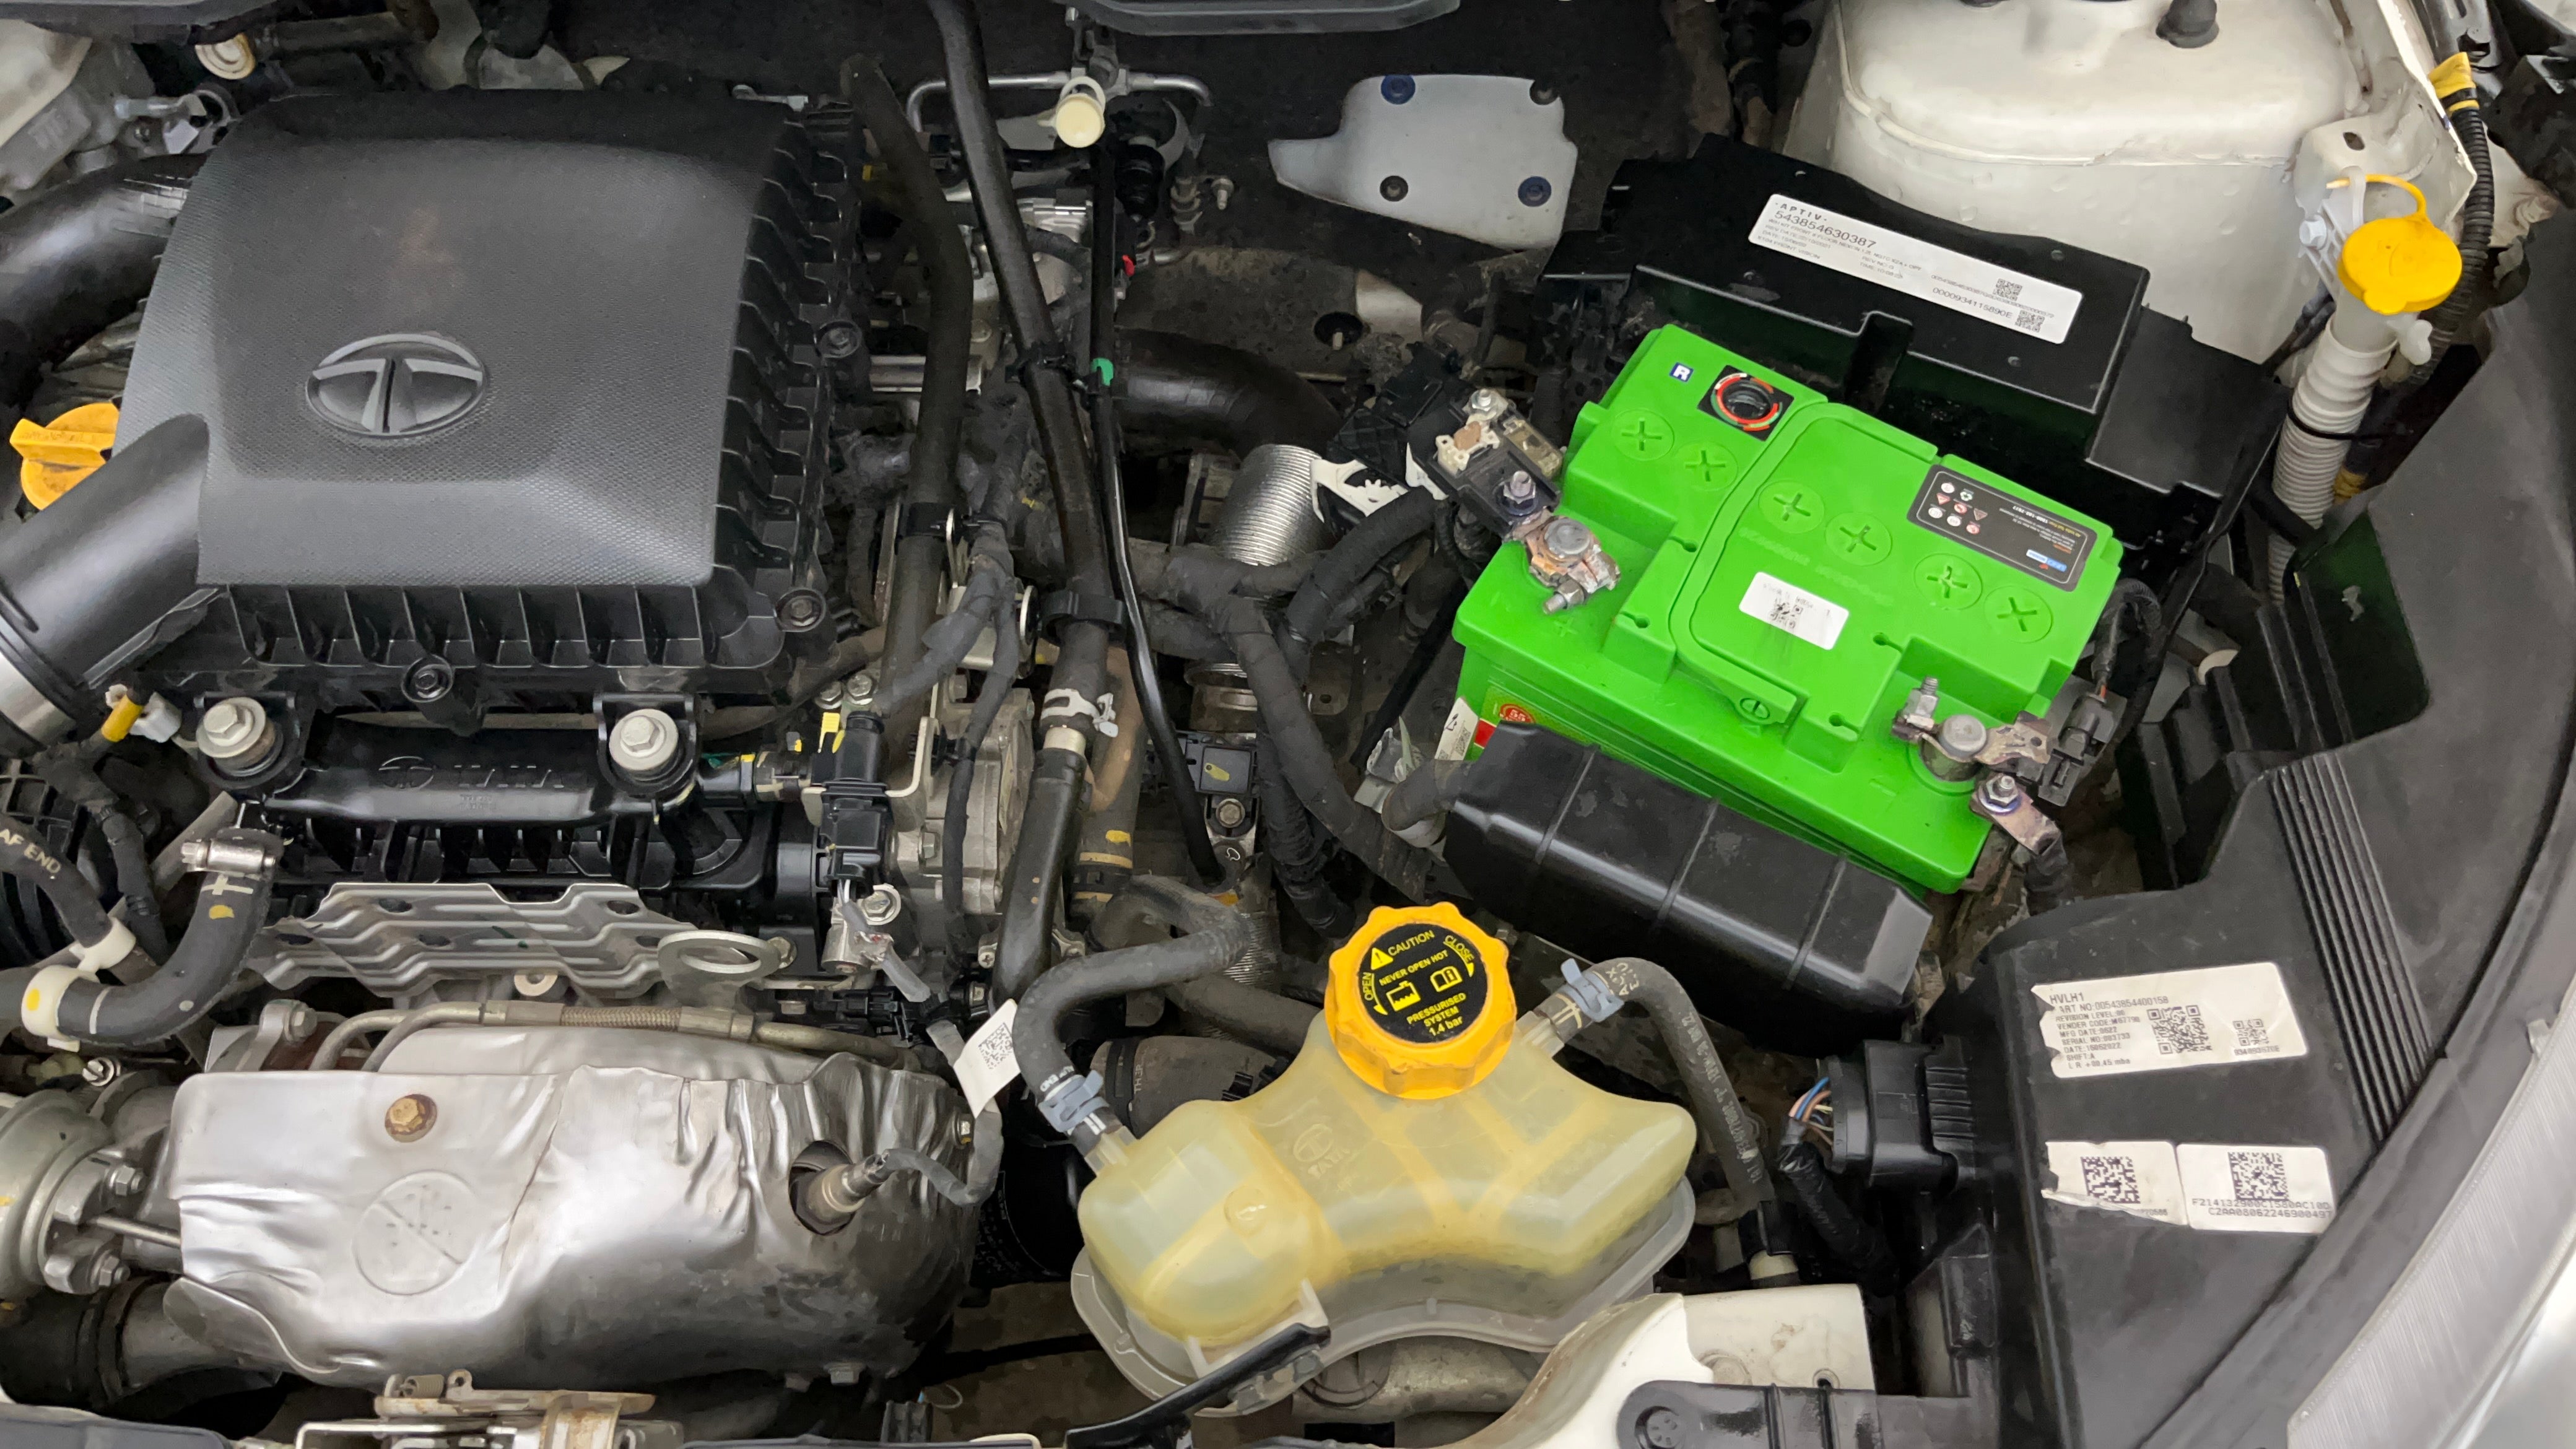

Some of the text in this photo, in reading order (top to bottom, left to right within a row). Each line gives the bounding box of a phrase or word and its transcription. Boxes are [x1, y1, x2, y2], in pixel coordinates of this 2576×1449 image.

[1774, 209, 1876, 250] 543854630387
[1672, 363, 1692, 381] R
[22, 842, 63, 877] END
[1388, 930, 1435, 956] CAUTION
[1444, 935, 1474, 963] CLOSE
[1379, 951, 1449, 985] NEVER OPEN HOT
[1362, 972, 1372, 1001] OPEN
[2049, 992, 2084, 1004] HVLH1
[1406, 993, 1466, 1024] PRESSURISED
[1424, 1007, 1459, 1026] SYSTEM
[2055, 1014, 2089, 1022] REVISION
[1429, 1016, 1463, 1036] 1.4 bar
[2057, 1021, 2087, 1030] VENDER
[2061, 1037, 2087, 1045] SERIAL
